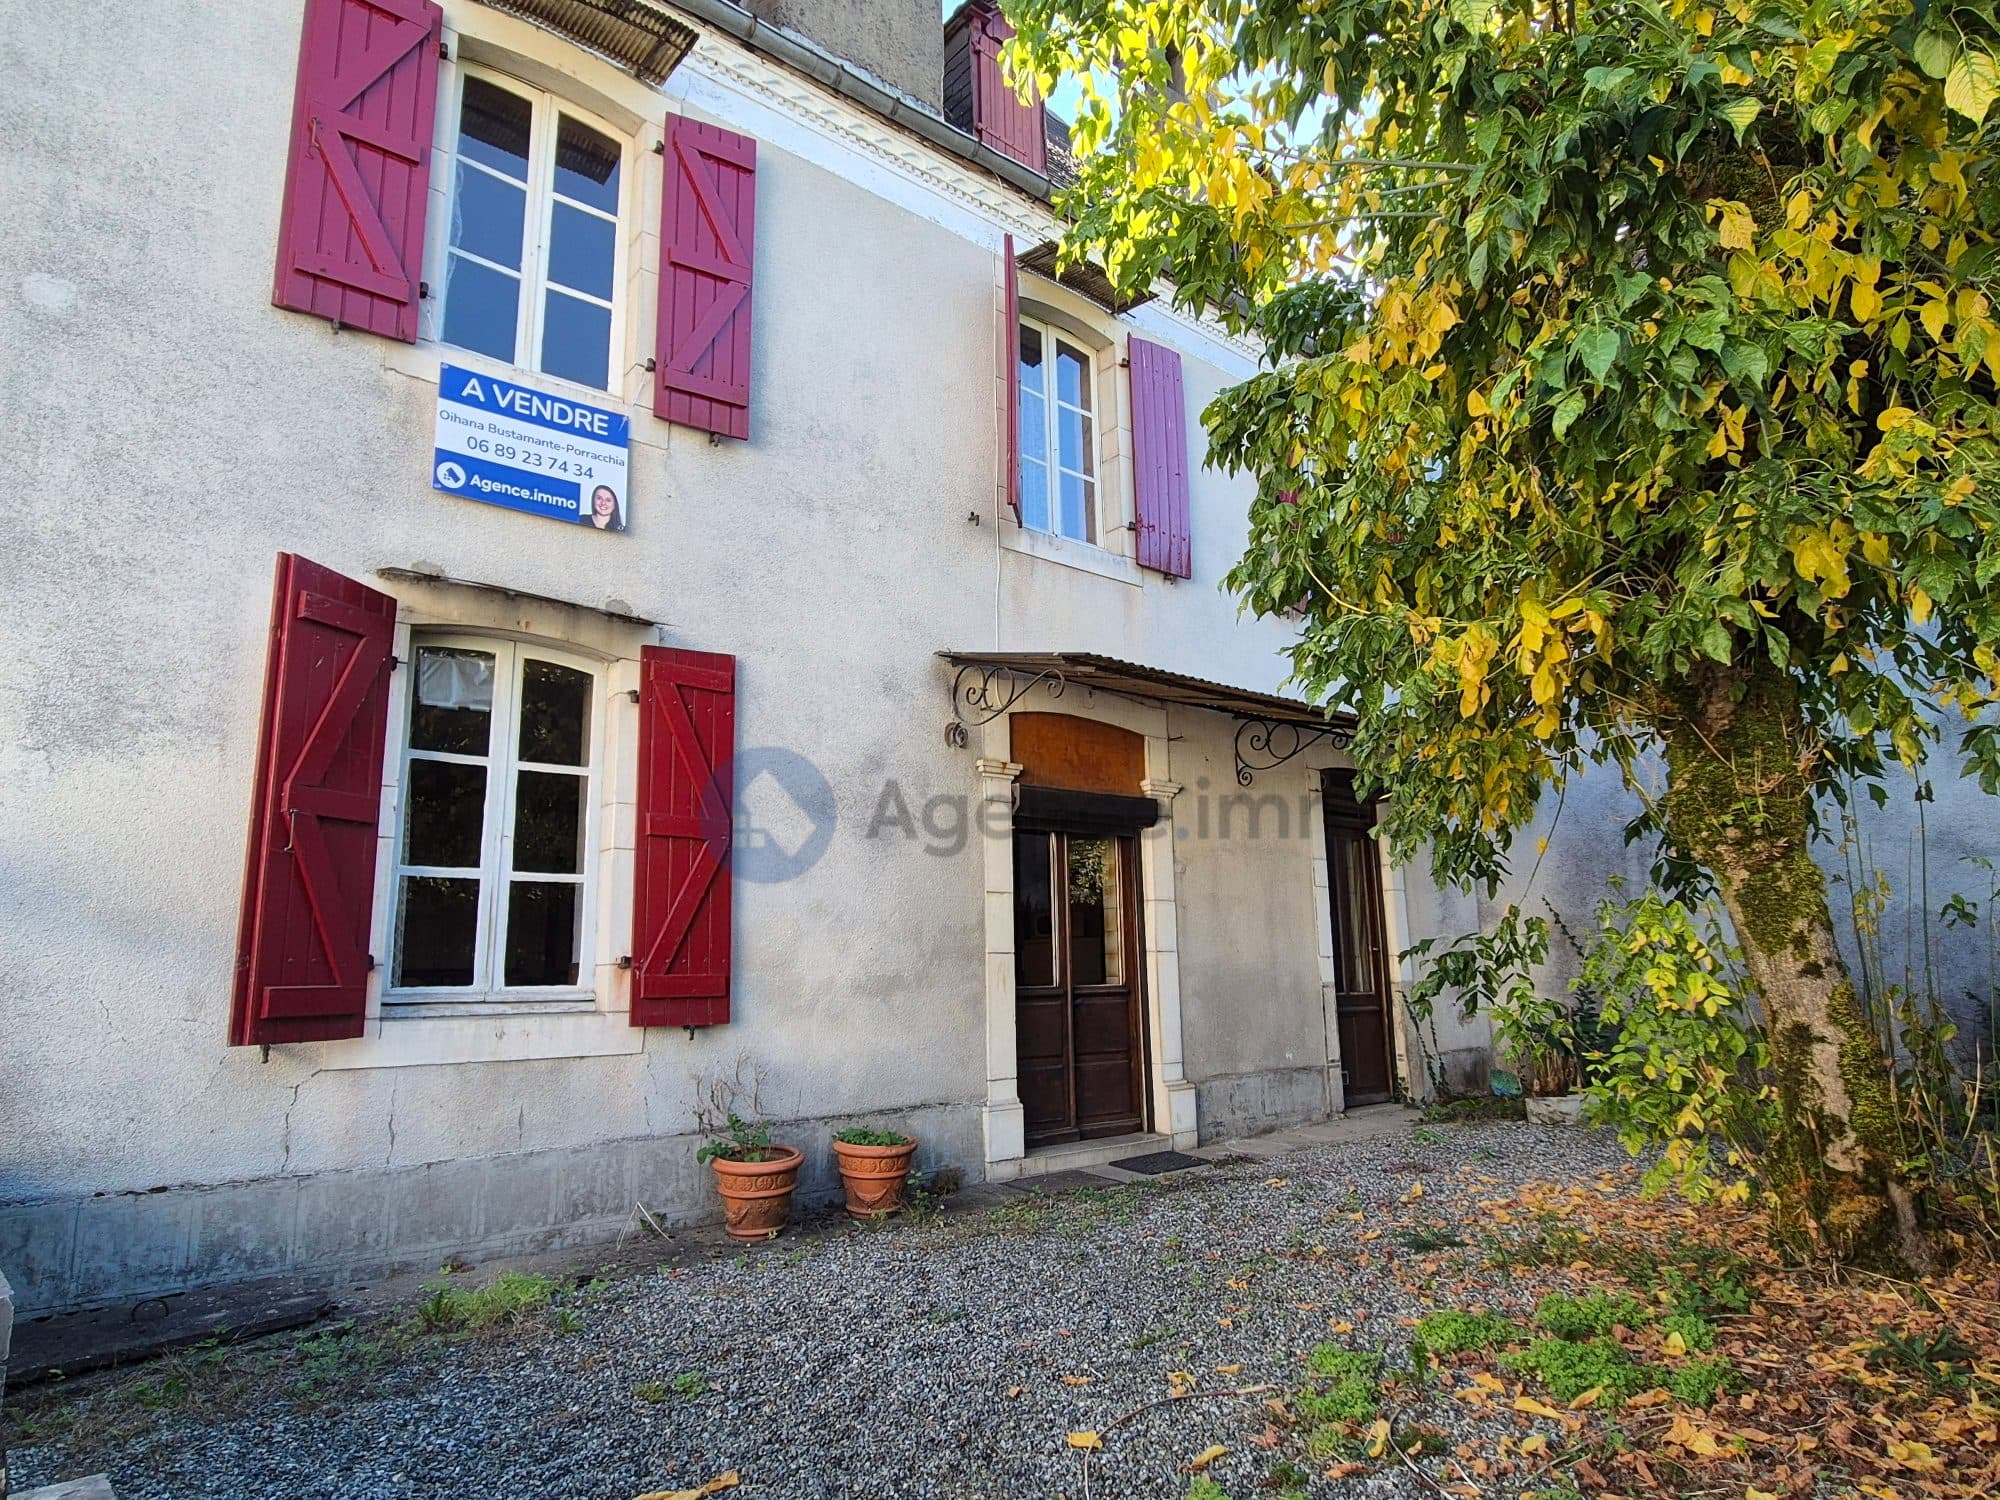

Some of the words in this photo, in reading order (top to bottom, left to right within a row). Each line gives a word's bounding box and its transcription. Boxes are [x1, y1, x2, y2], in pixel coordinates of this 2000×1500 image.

[461, 377, 485, 403] A
[492, 383, 609, 436] VENDRE
[439, 409, 485, 431] Oihana
[488, 422, 625, 467] Bustamante-Porracchia
[466, 435, 490, 453] 06
[494, 443, 517, 460] 89
[521, 450, 543, 467] 23
[547, 456, 569, 474] 74
[573, 463, 594, 479] 34
[470, 474, 577, 510] Agence.immo
